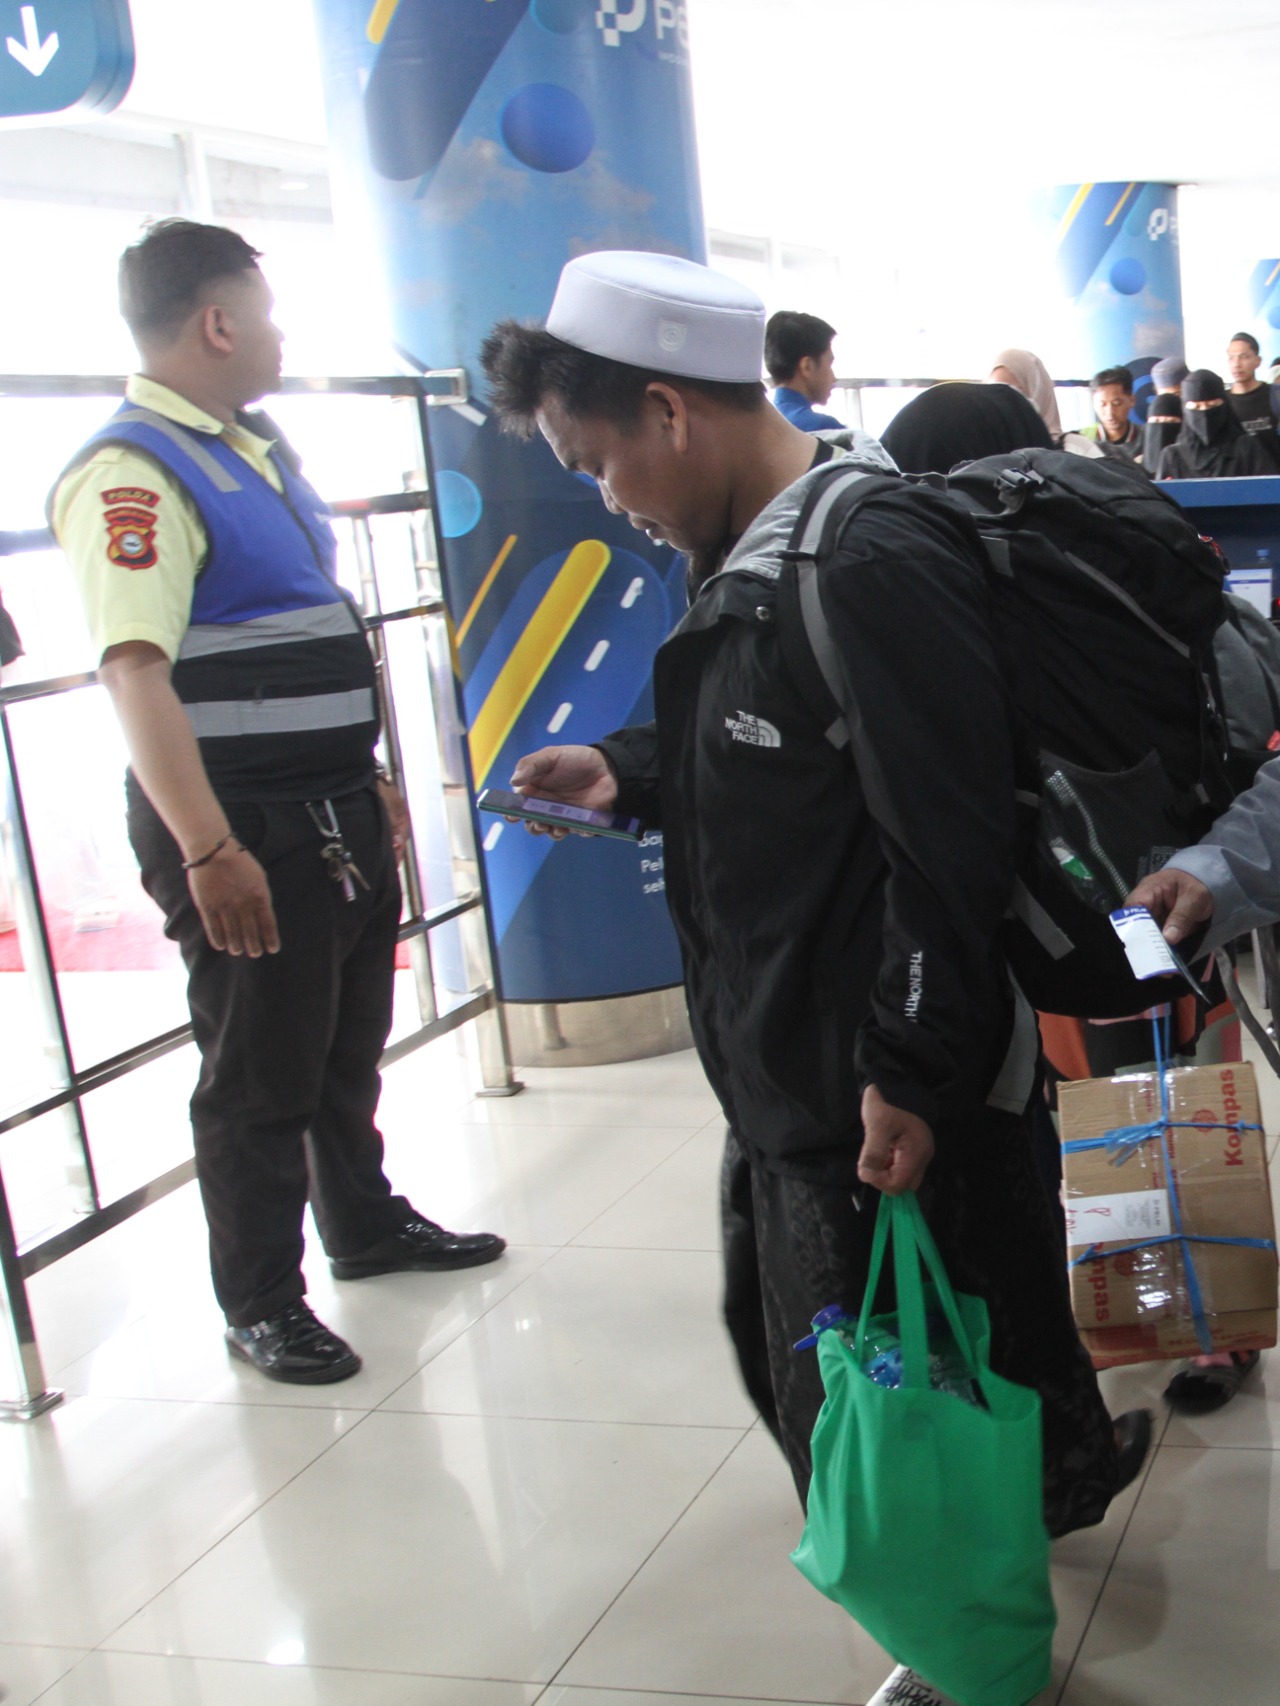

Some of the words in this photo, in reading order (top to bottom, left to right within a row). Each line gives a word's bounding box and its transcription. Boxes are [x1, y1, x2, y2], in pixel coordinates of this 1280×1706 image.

[724, 717, 758, 736] NORTH
[736, 710, 756, 726] THE
[732, 730, 758, 746] FACE
[909, 951, 923, 978] THE
[904, 977, 922, 1017] NORTH
[1219, 1068, 1246, 1167] Kompas
